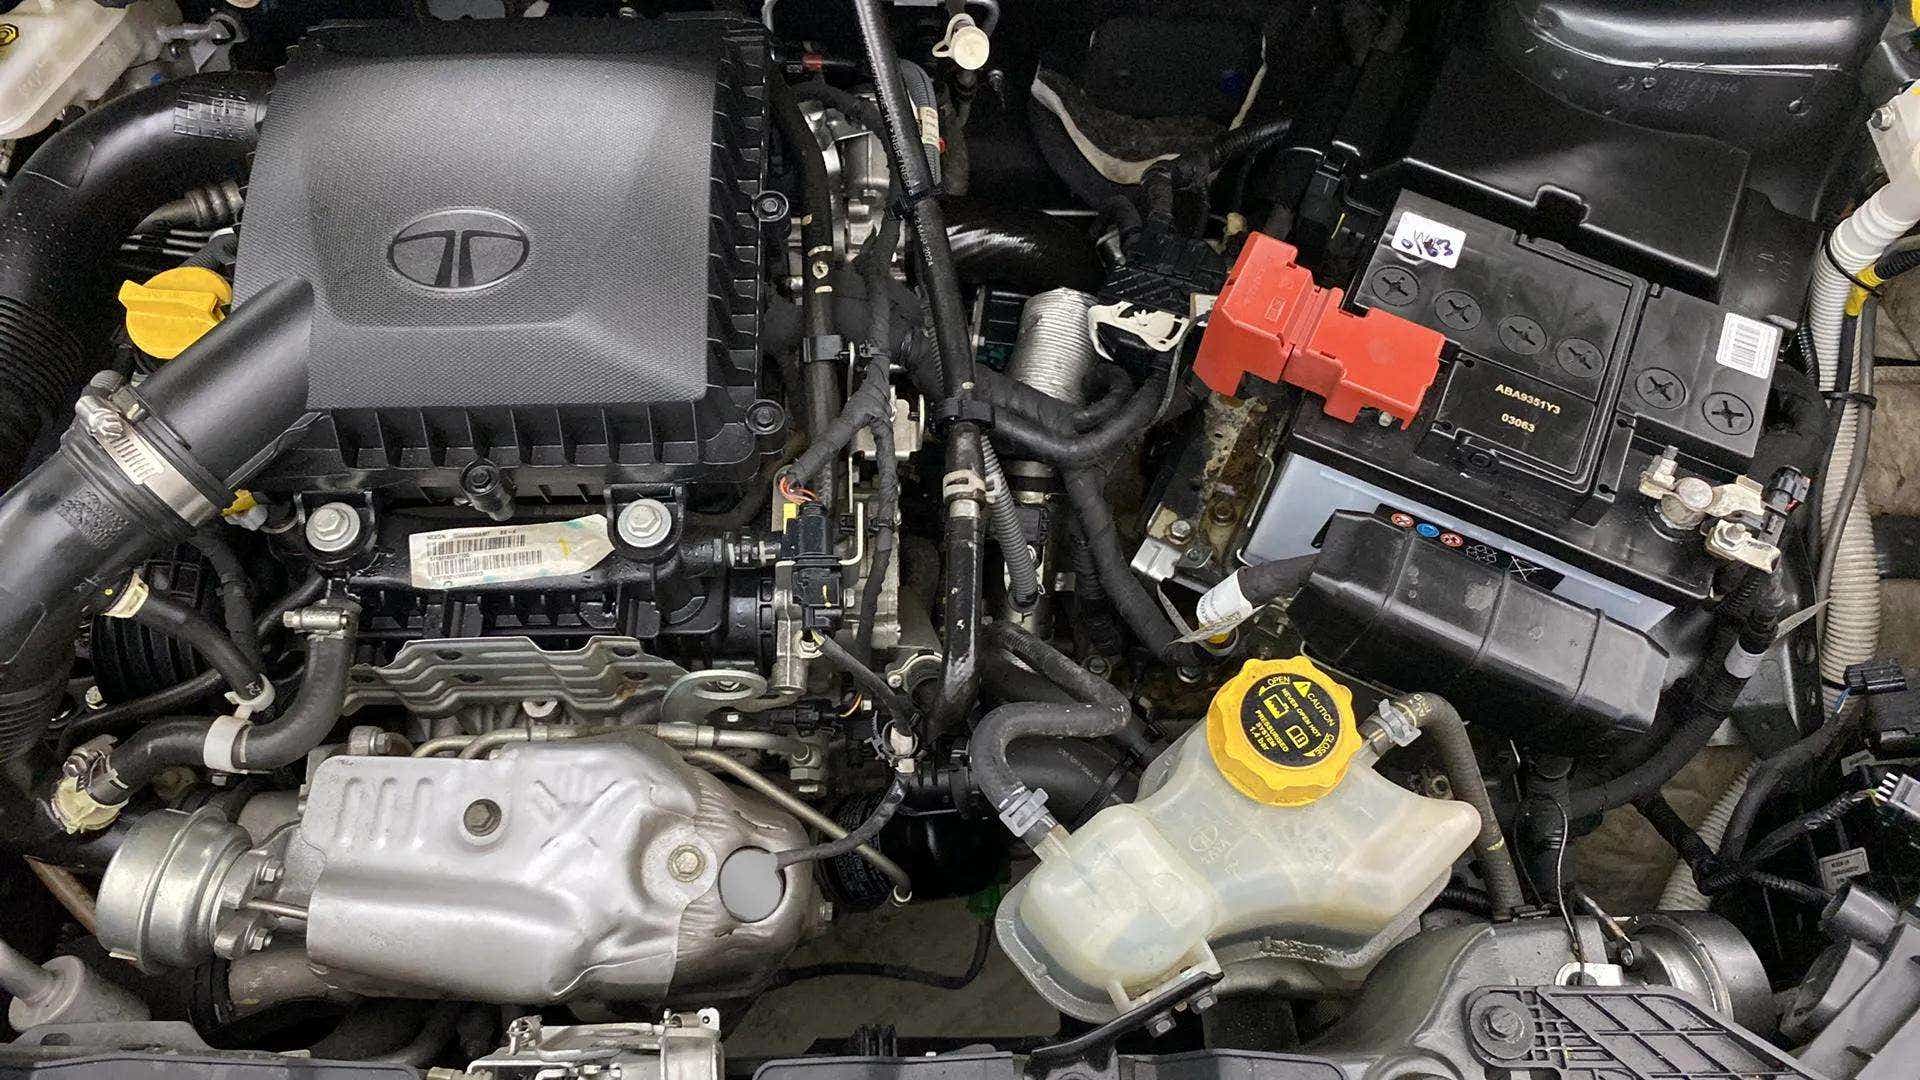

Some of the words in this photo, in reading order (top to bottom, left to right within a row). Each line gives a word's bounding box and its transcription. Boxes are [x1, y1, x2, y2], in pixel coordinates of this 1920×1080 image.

[1494, 382, 1561, 417] ABA9351Y3
[1501, 412, 1537, 434] 03063
[1267, 676, 1291, 686] OPEN
[1281, 688, 1299, 709] NEVER
[1296, 708, 1312, 726] OPEN
[1308, 724, 1322, 738] HOT
[1307, 692, 1336, 727] CAUTION
[1249, 727, 1260, 739] 1.4
[1256, 737, 1270, 751] bar
[1255, 722, 1277, 748] SYSTEM
[1315, 734, 1335, 757] CLOSE
